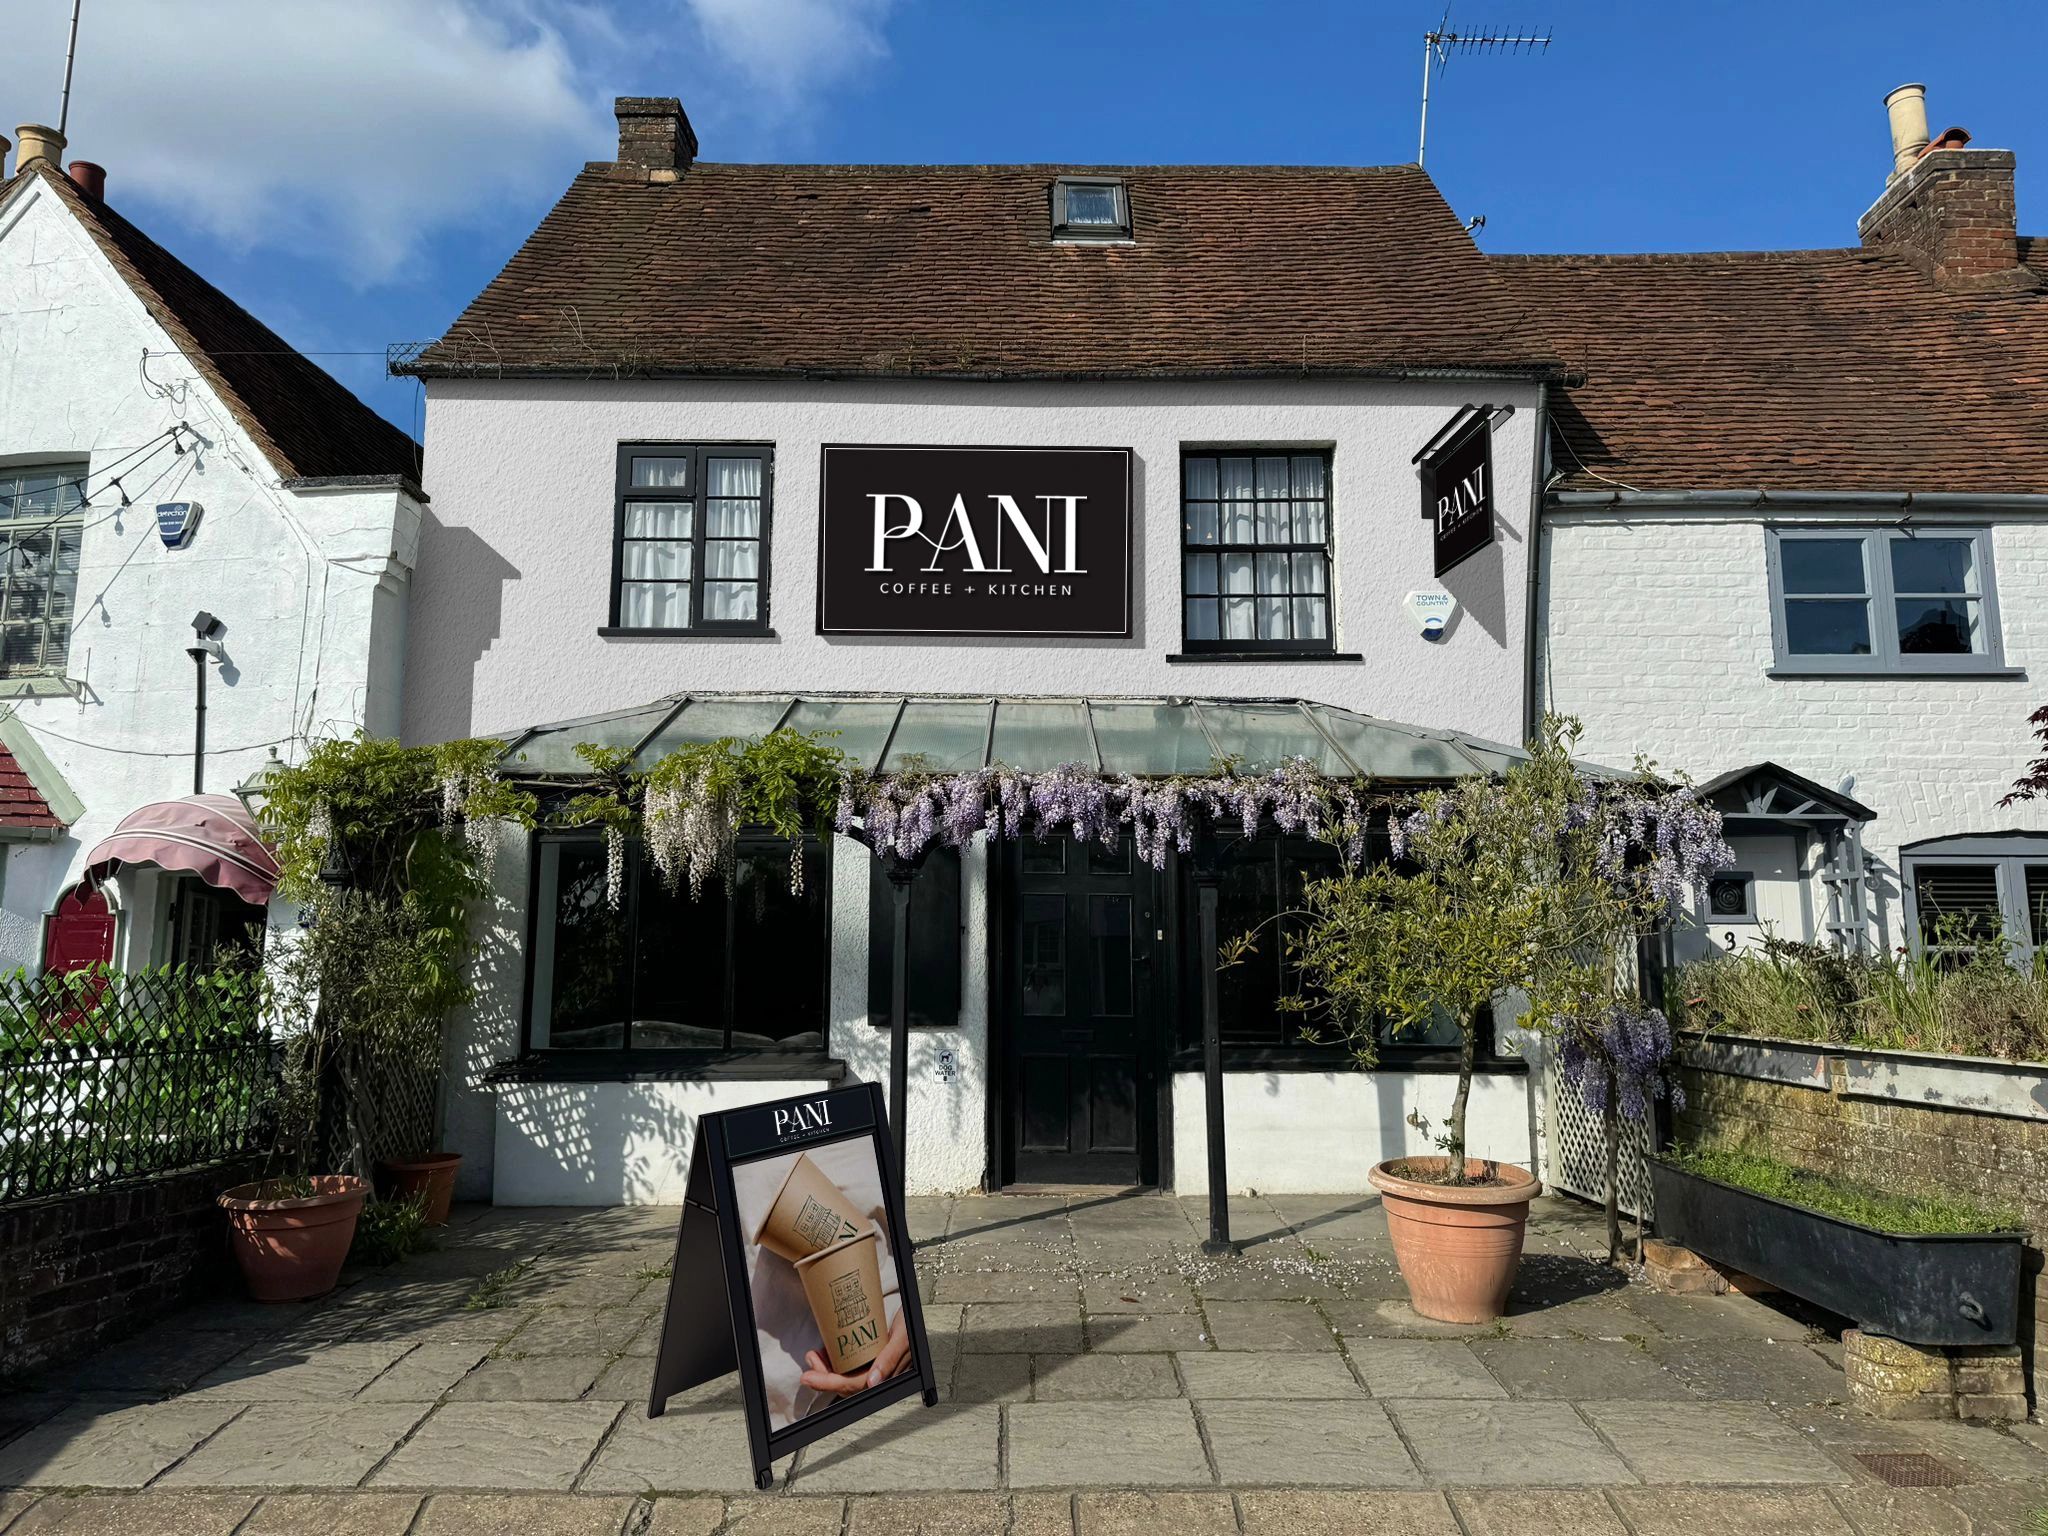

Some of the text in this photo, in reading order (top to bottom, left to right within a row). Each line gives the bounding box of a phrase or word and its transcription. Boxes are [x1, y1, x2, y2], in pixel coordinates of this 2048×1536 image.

[1437, 462, 1486, 534] PANI
[864, 493, 1088, 574] PANI
[880, 582, 1073, 596] COFFEE + KITCHEN
[1724, 931, 1736, 951] 3
[771, 1099, 833, 1136] PANI
[837, 1318, 881, 1357] PANI
